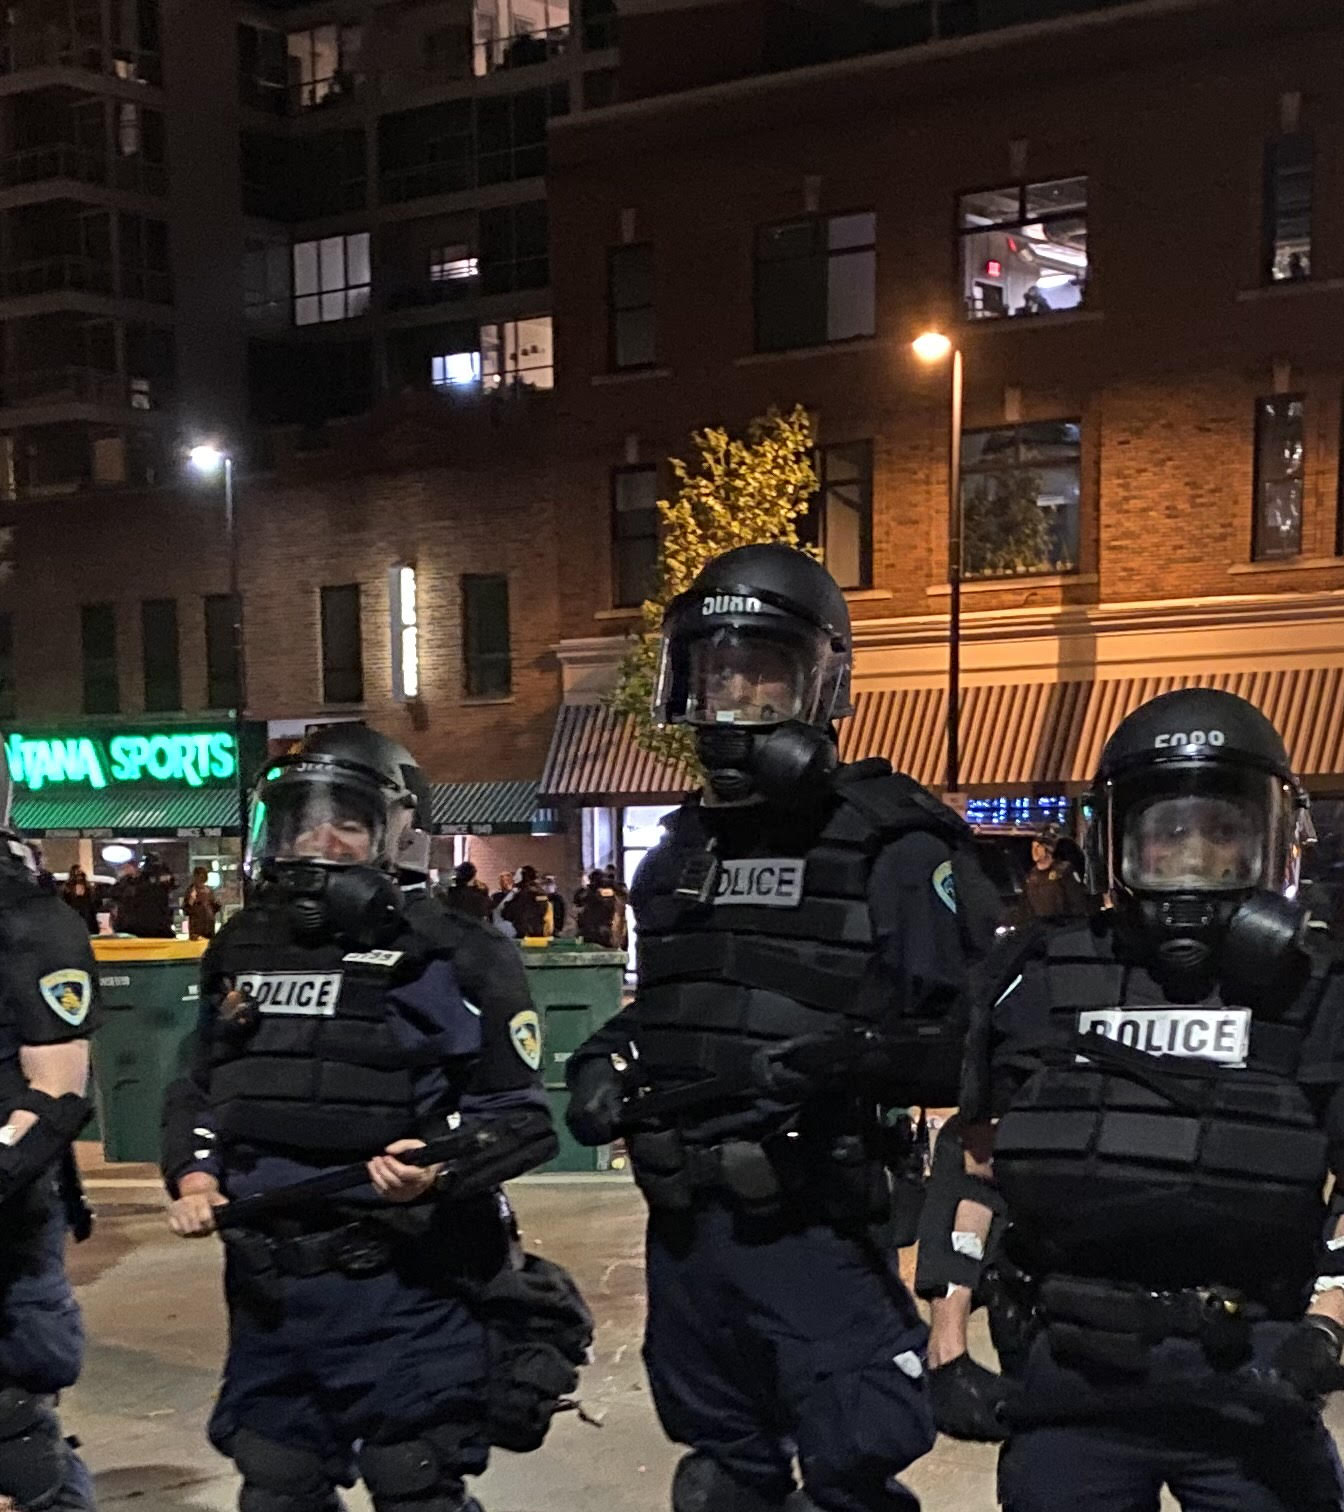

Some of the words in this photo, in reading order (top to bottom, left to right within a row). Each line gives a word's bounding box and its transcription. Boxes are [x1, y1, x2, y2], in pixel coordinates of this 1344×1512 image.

[110, 732, 235, 787] SPORTS
[712, 867, 797, 897] OLICE
[240, 980, 332, 1008] POLICE
[1089, 1018, 1237, 1053] POLICE
